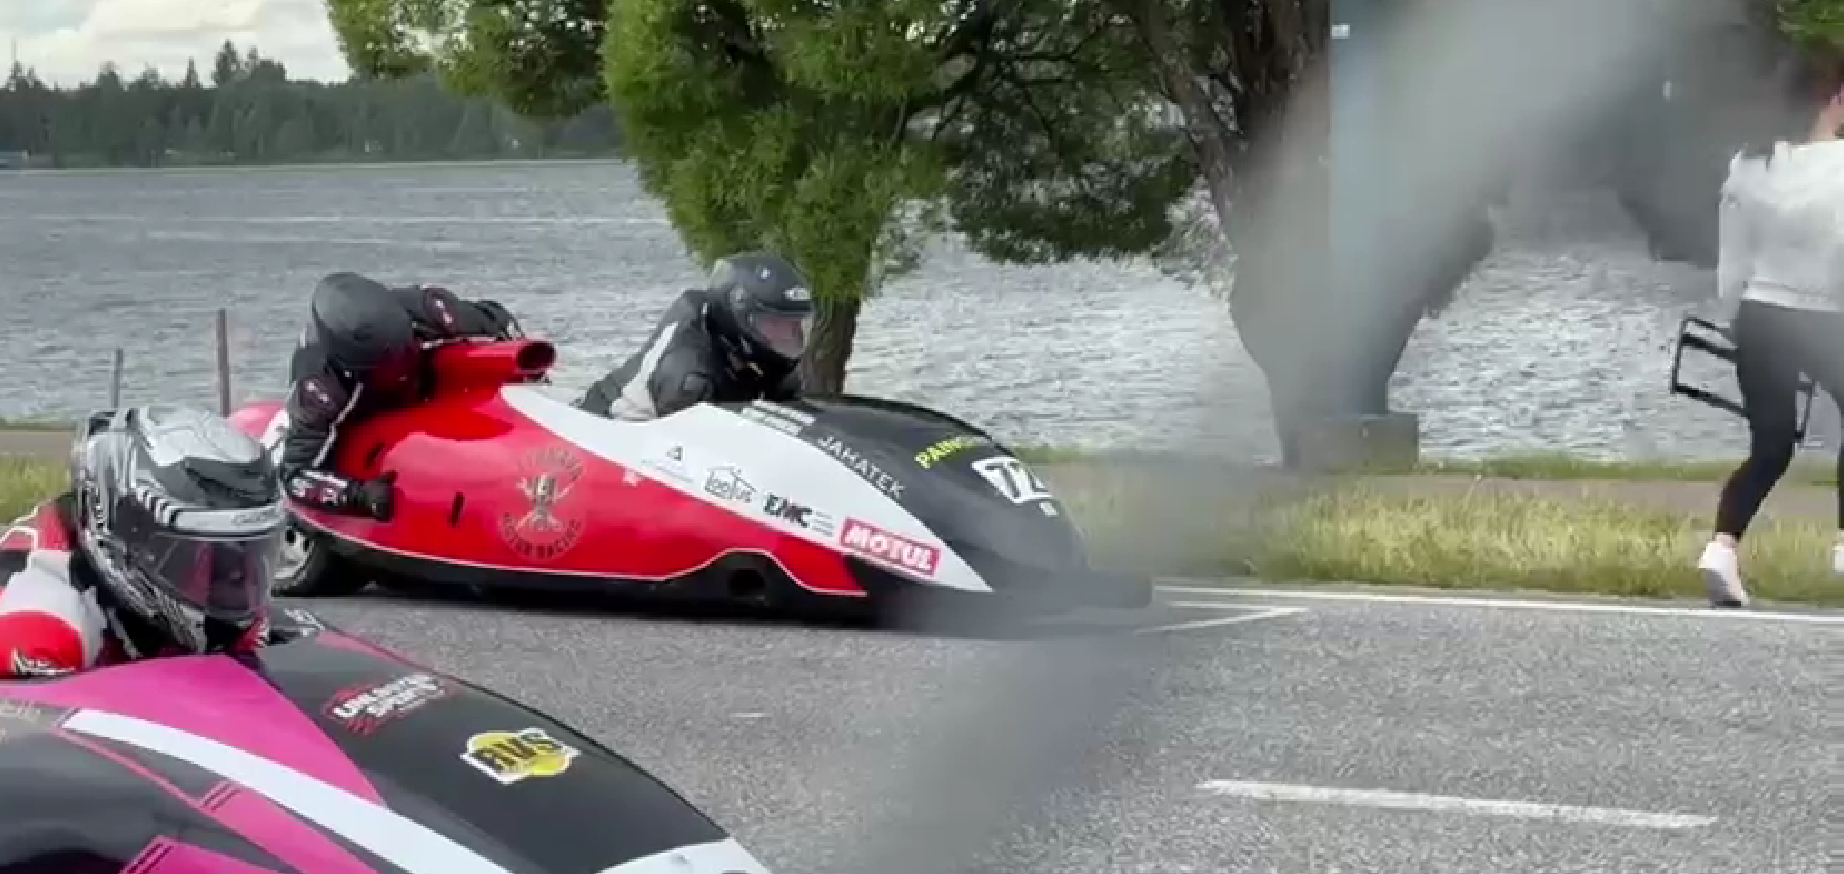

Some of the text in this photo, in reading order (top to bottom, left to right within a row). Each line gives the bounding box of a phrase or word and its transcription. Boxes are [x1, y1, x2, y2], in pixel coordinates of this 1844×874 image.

[818, 436, 906, 499] JAMATEK
[763, 493, 813, 528] EMC
[844, 525, 932, 571] MOTUL
[469, 733, 561, 771] RVS
